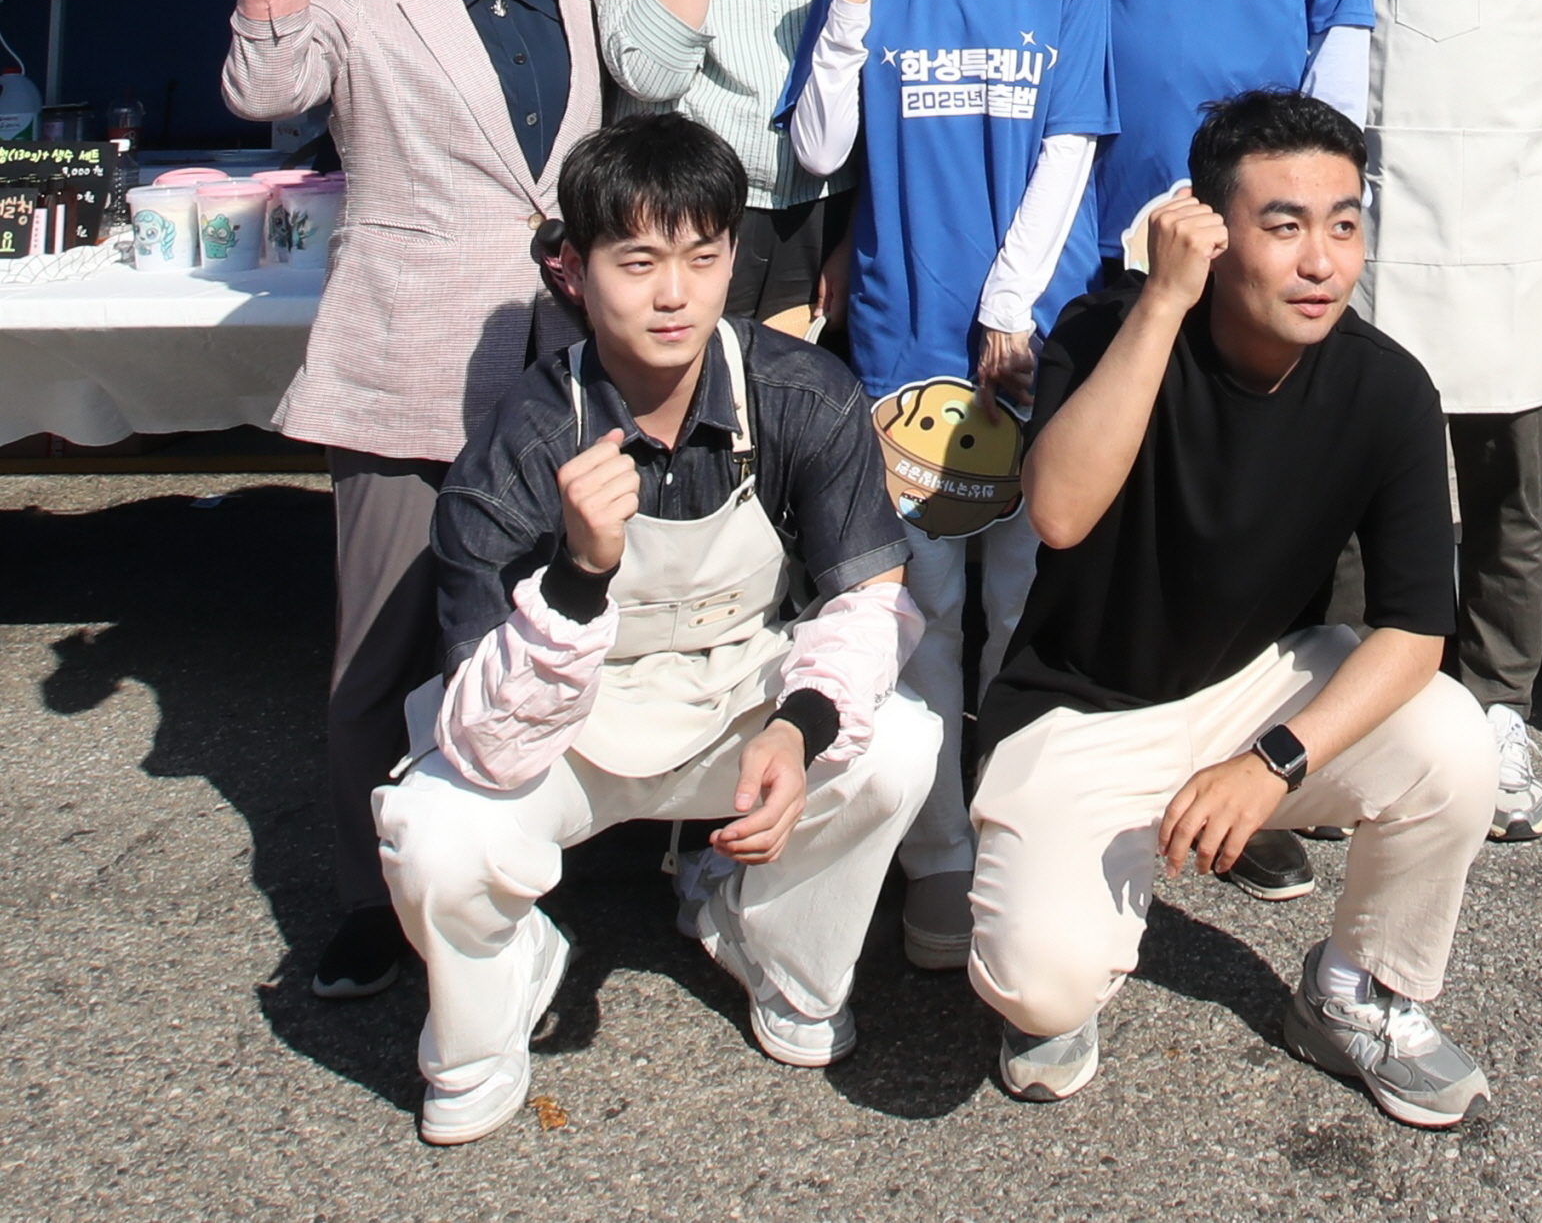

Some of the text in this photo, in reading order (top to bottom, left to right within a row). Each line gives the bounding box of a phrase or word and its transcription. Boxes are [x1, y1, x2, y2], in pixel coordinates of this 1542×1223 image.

[900, 48, 1044, 86] 화성특례시
[906, 83, 1039, 119] 2025년 출범
